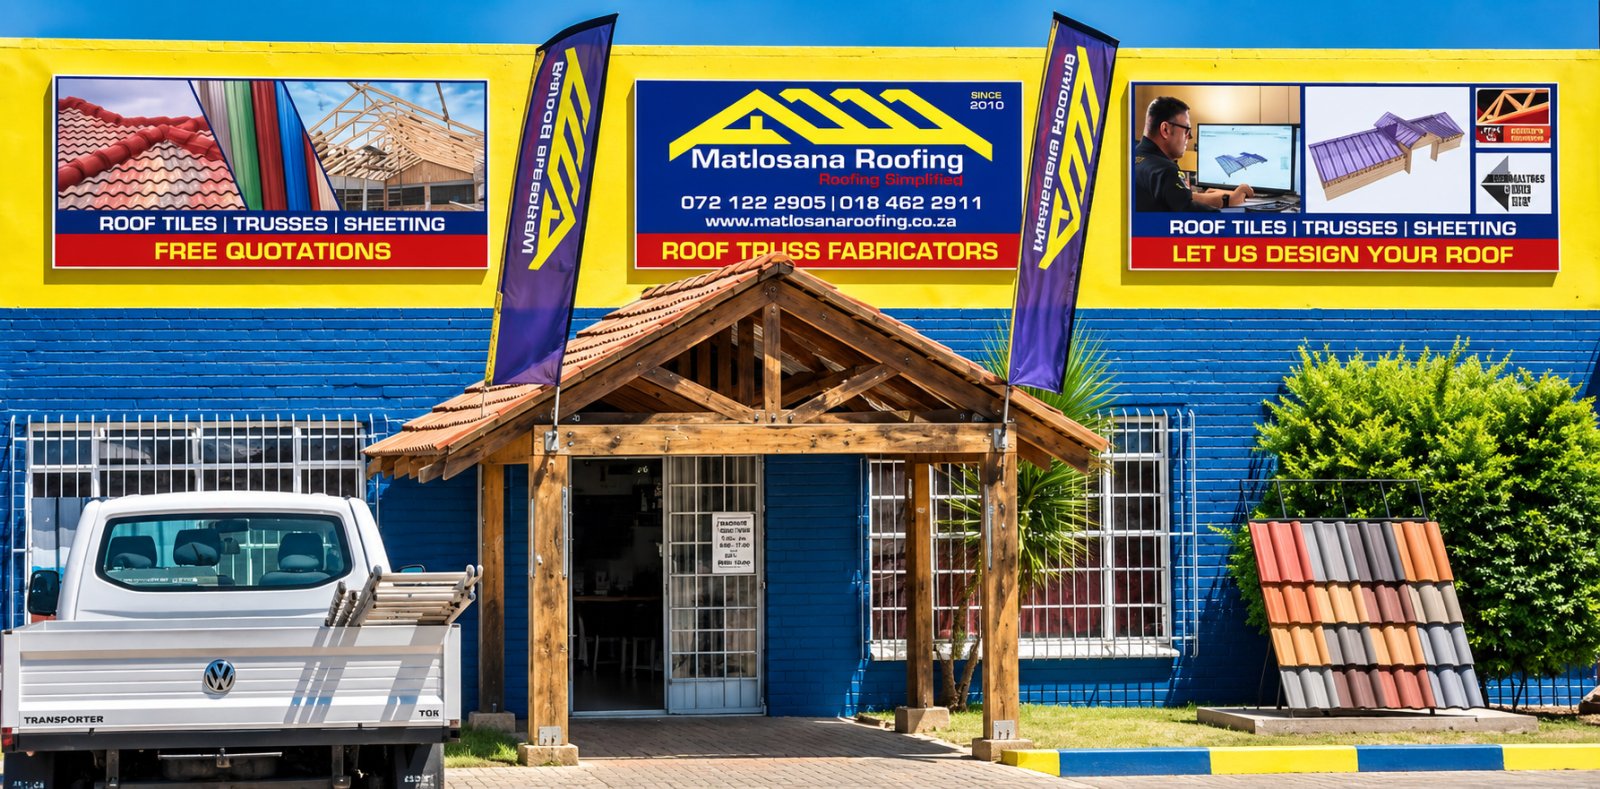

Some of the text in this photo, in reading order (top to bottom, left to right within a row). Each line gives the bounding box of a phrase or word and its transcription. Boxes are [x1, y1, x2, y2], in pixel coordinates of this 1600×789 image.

[970, 101, 1005, 110] 2010
[691, 148, 963, 173] Matlosana Roofing
[819, 173, 963, 188] Roofing Simplified
[681, 195, 981, 210] 072 122 2905 018 462 2911
[100, 216, 445, 232] ROOF TILES TRUSSES SHEETING
[705, 214, 957, 231] www.matlosanaroofing.co.za
[1170, 219, 1517, 236] ROOF TILES TRUSSES SHEETING
[154, 241, 392, 261] FREE QUOTATIONS
[661, 241, 999, 261] ROOF TRUSS FABRICATORS
[1172, 244, 1514, 264] LET US DESIGN YOUR ROOF
[24, 715, 104, 724] TRANSPORTER
